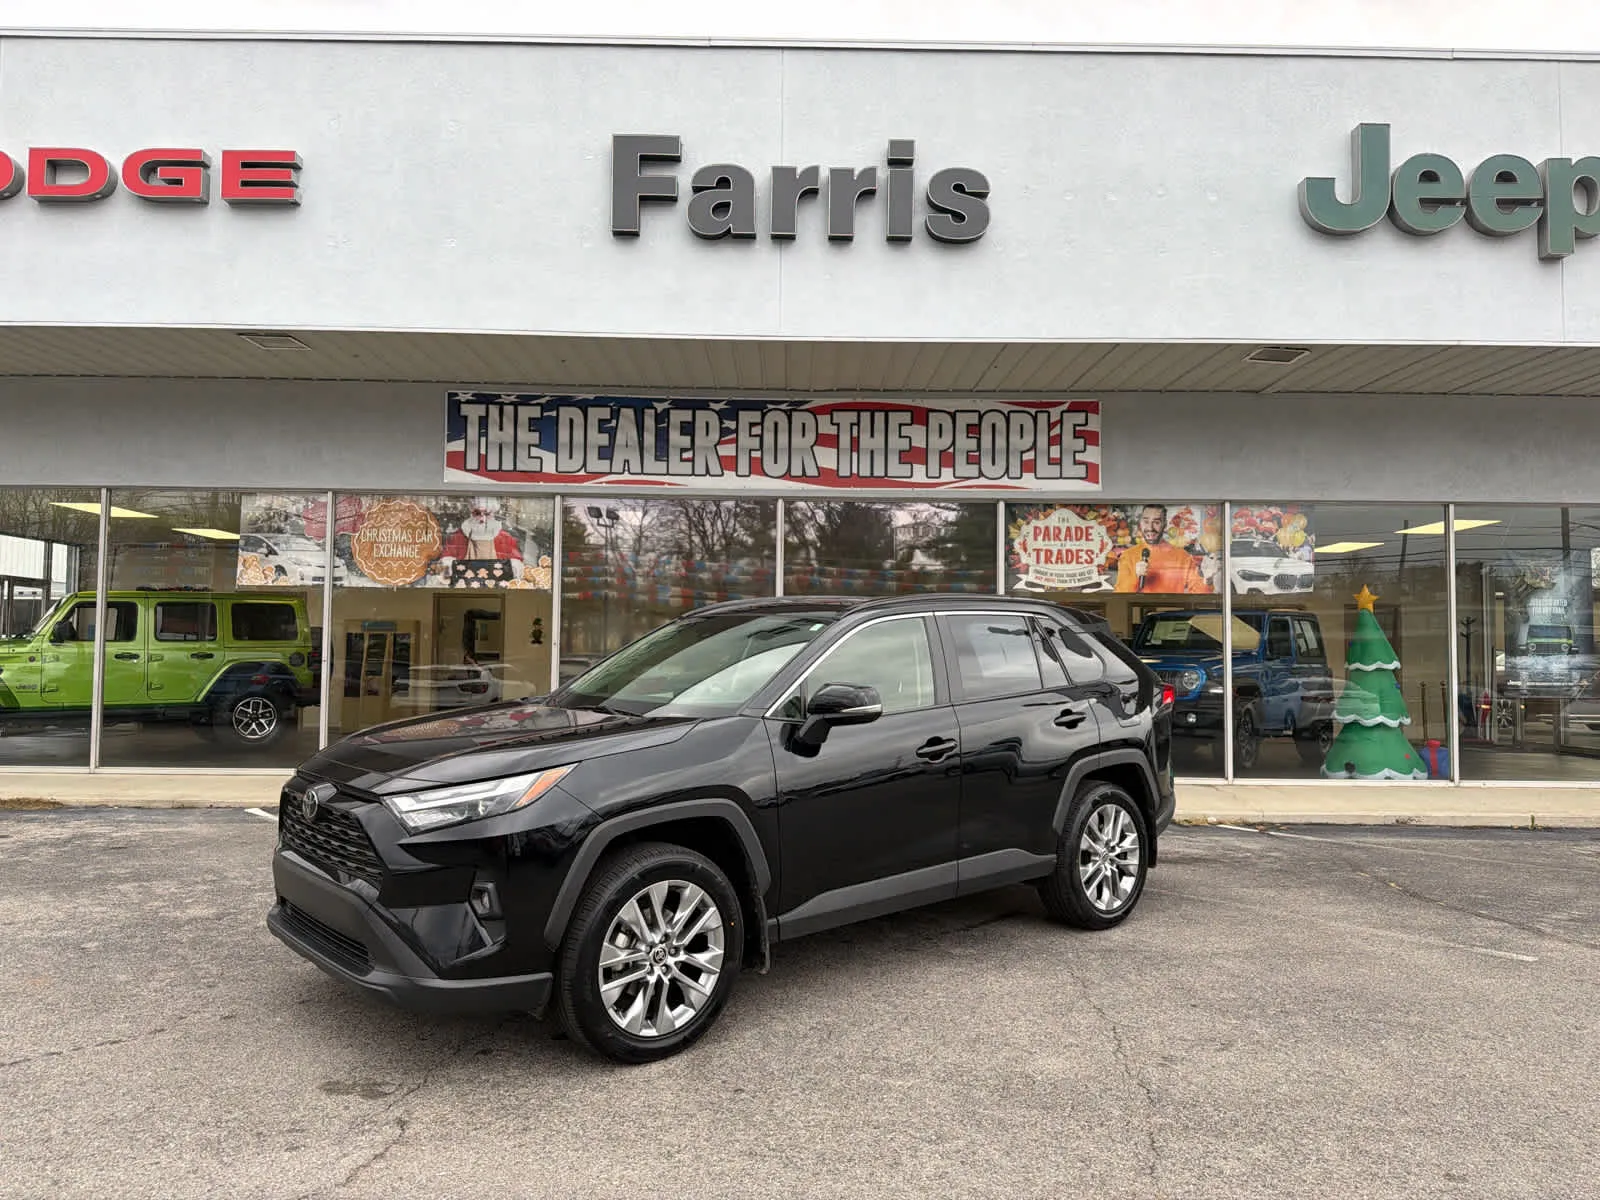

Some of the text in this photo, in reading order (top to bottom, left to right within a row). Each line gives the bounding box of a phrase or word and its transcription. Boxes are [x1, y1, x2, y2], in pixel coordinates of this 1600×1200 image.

[0, 147, 303, 206] DGE
[610, 134, 992, 244] Farris
[1297, 122, 1600, 260] Jeep
[459, 402, 1089, 480] THE DEALER FOR THE PEOPLE
[361, 528, 434, 544] CHRISTMAS CAR
[373, 543, 420, 558] EXCHANGE
[1032, 525, 1095, 542] PARADE
[1031, 548, 1095, 565] TRADES
